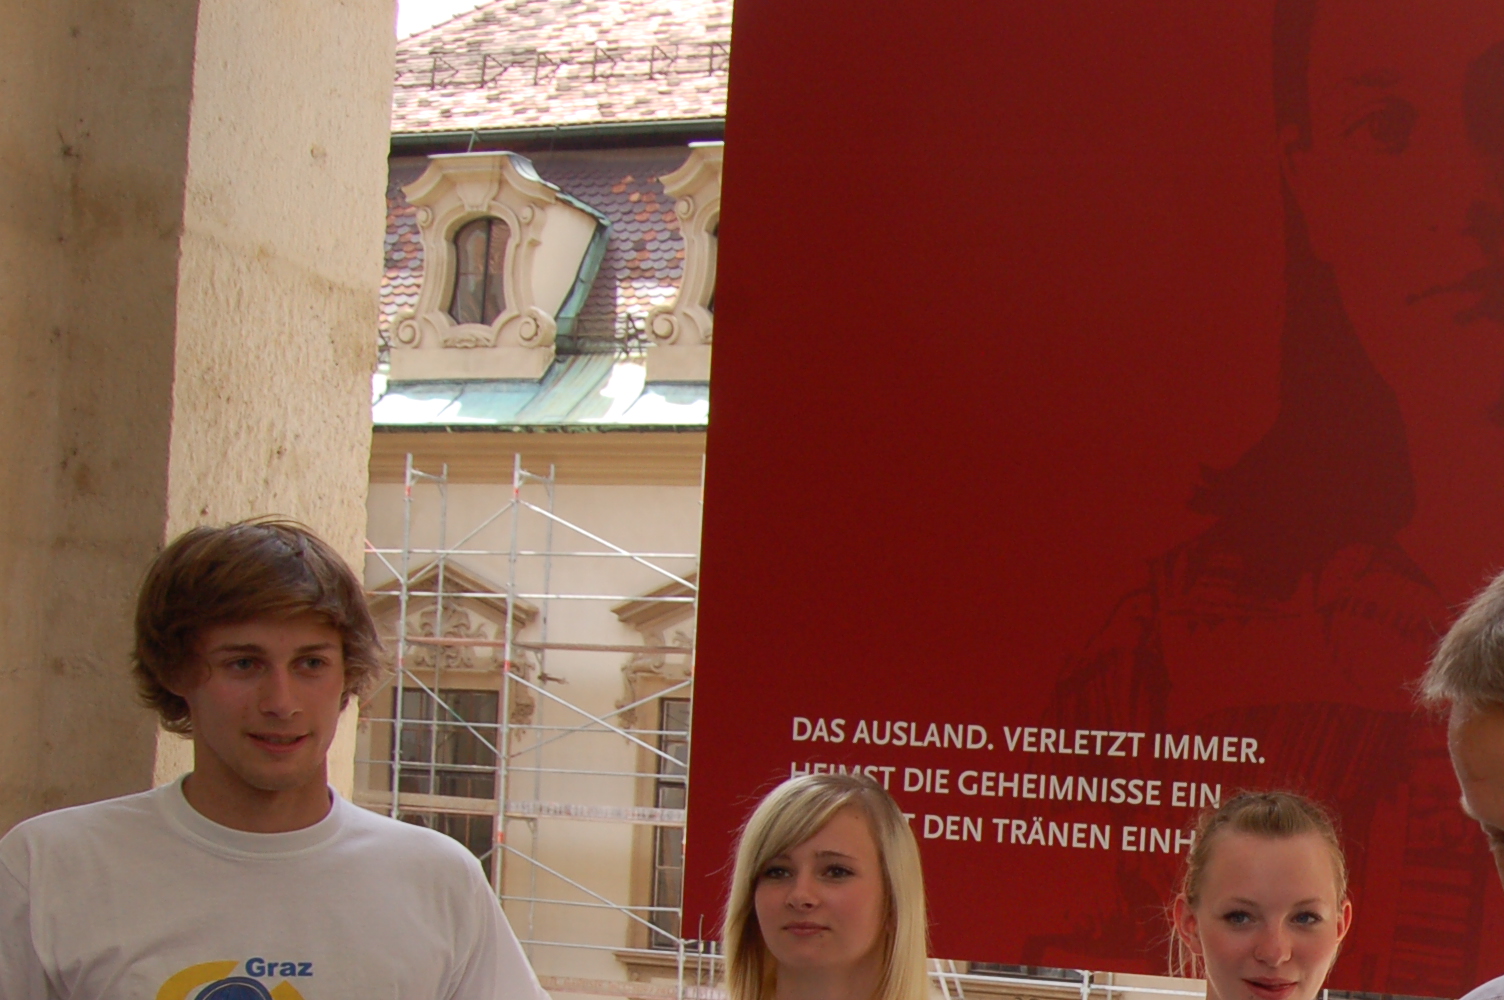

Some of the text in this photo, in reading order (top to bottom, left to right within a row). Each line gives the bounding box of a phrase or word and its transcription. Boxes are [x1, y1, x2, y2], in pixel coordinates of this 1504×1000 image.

[792, 716, 1266, 765] DAS AUSLAND. VERLETZT IMMER.
[903, 767, 950, 794] DIE
[957, 770, 1162, 806] GEHEIMNISSE
[1171, 781, 1222, 810] EIN
[923, 813, 983, 843] DEN
[992, 816, 1111, 851] TRÄNEN
[245, 957, 313, 977] Graz
